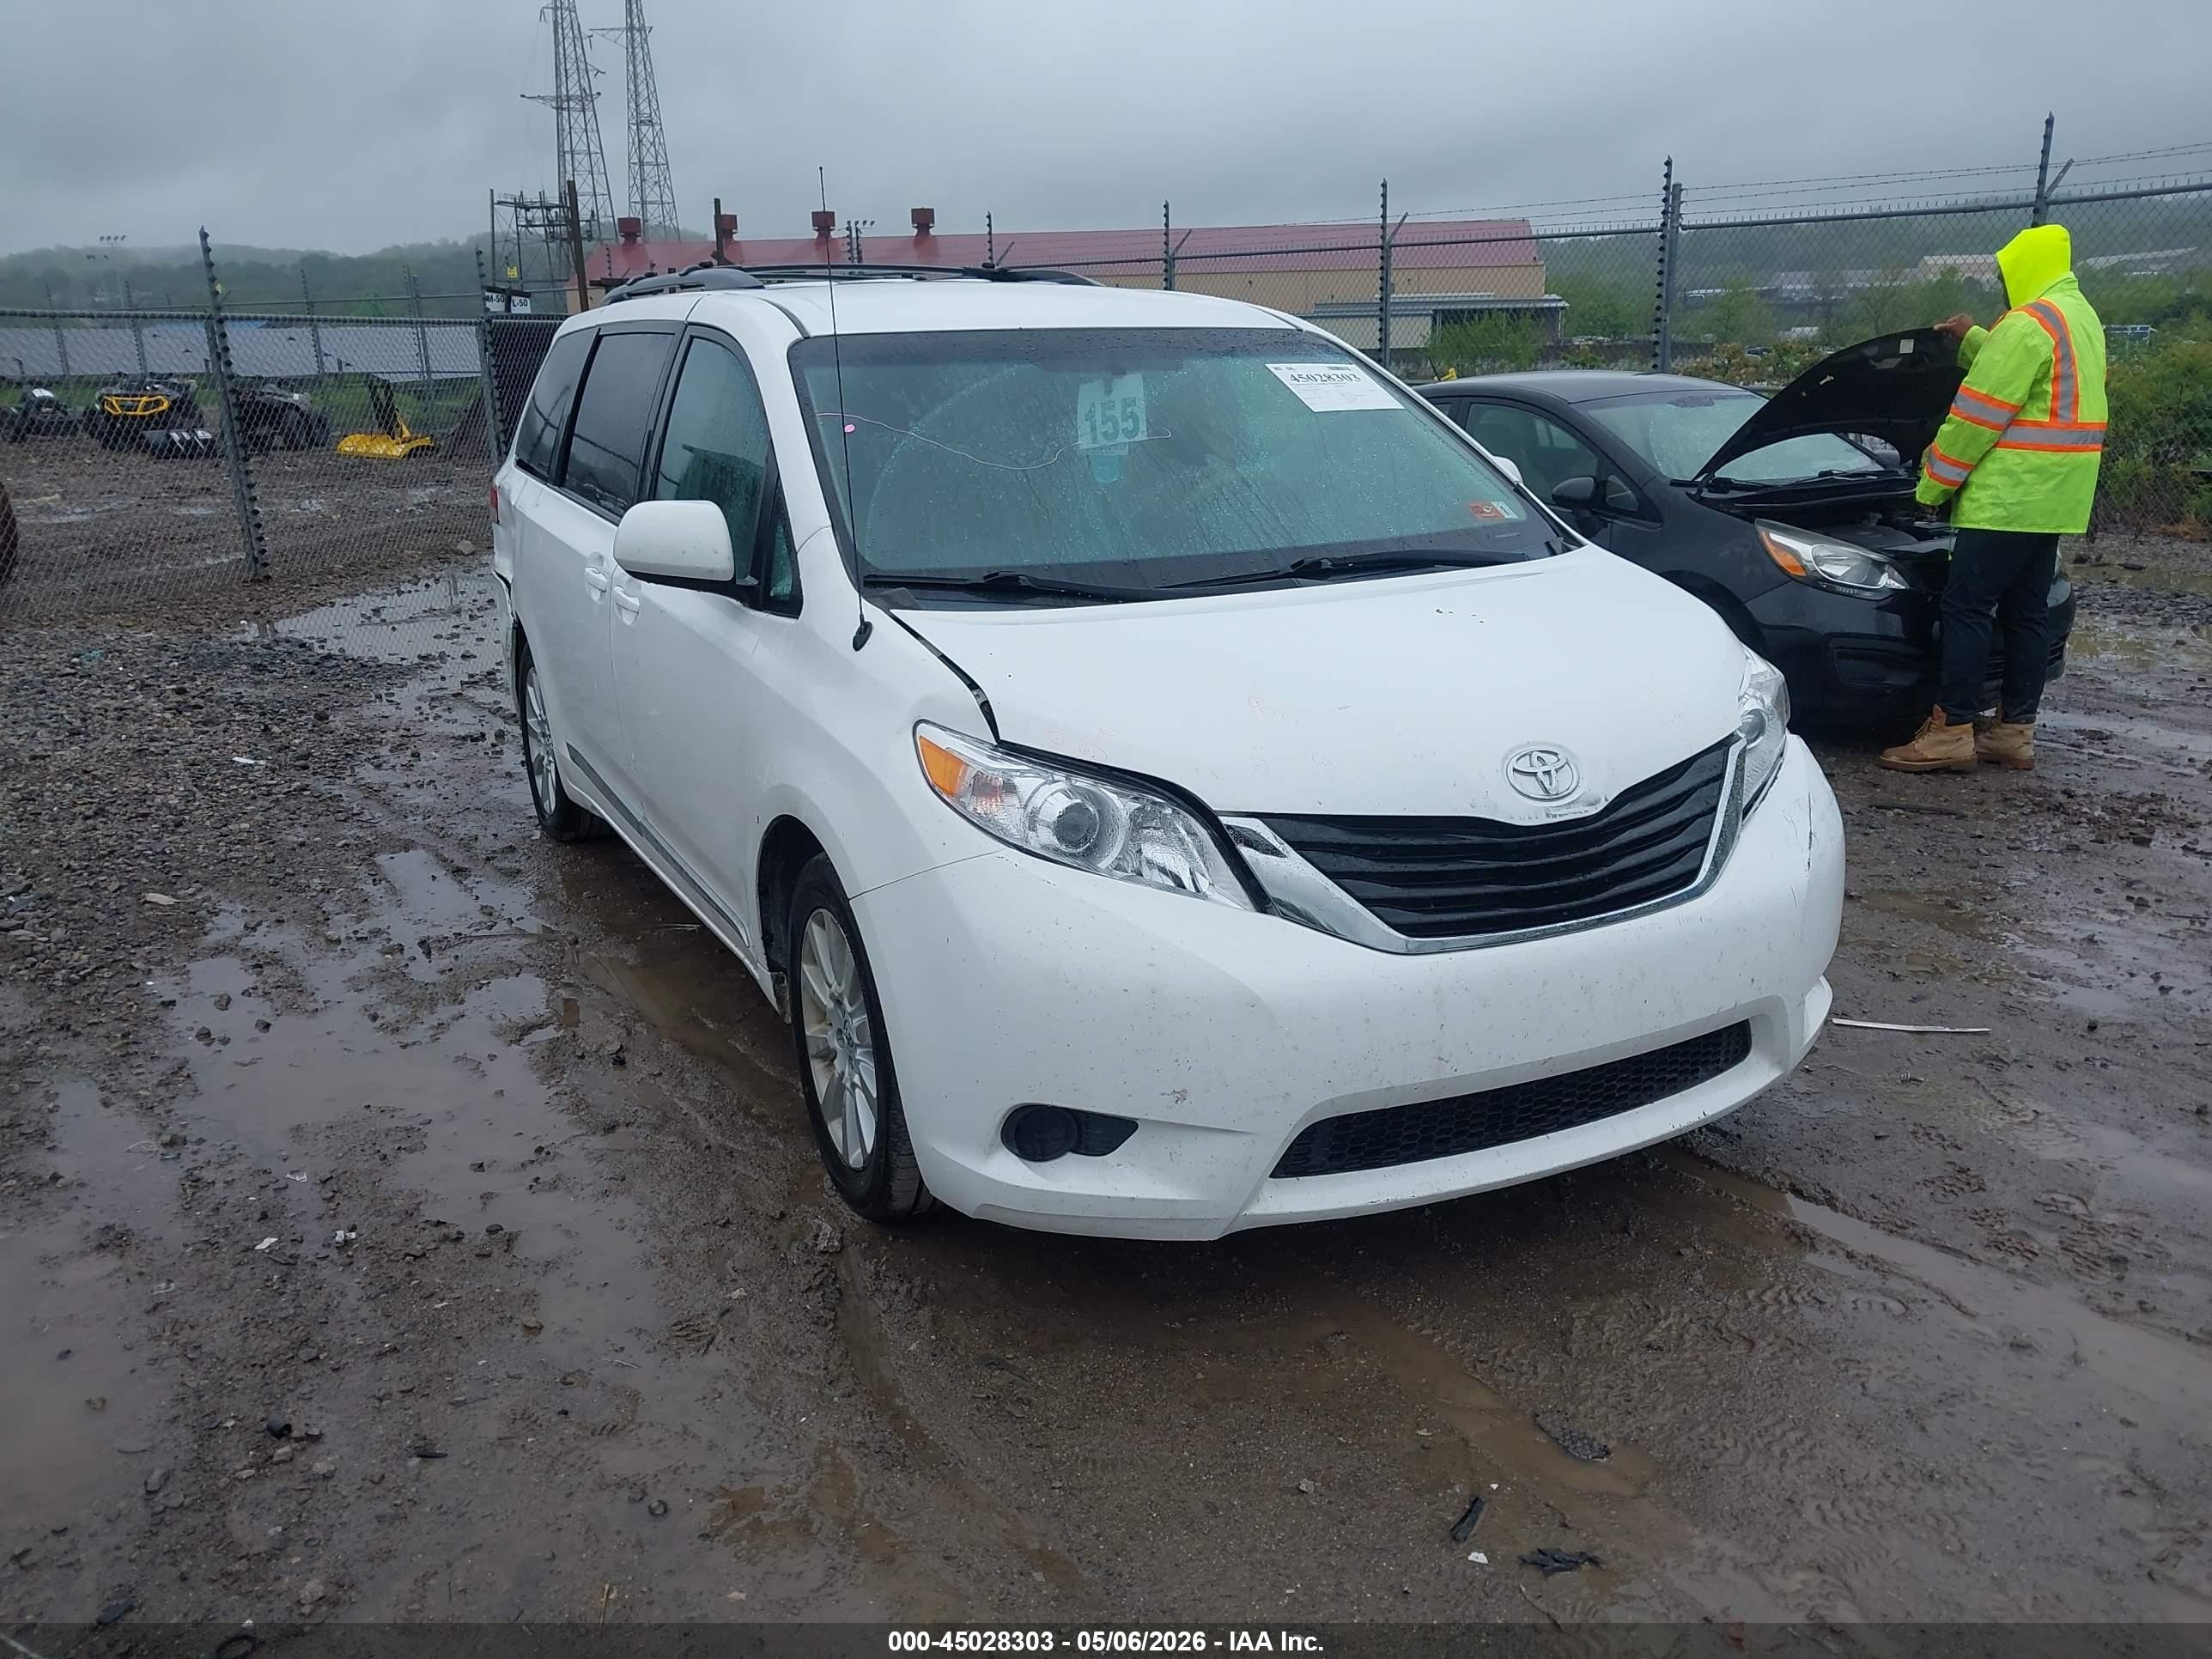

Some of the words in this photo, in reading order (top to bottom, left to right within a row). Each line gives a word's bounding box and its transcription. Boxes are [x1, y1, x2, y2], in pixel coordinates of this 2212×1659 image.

[487, 295, 505, 303] M-50
[512, 298, 528, 307] L-50
[1290, 373, 1362, 384] 45028303
[1085, 397, 1140, 445] 155
